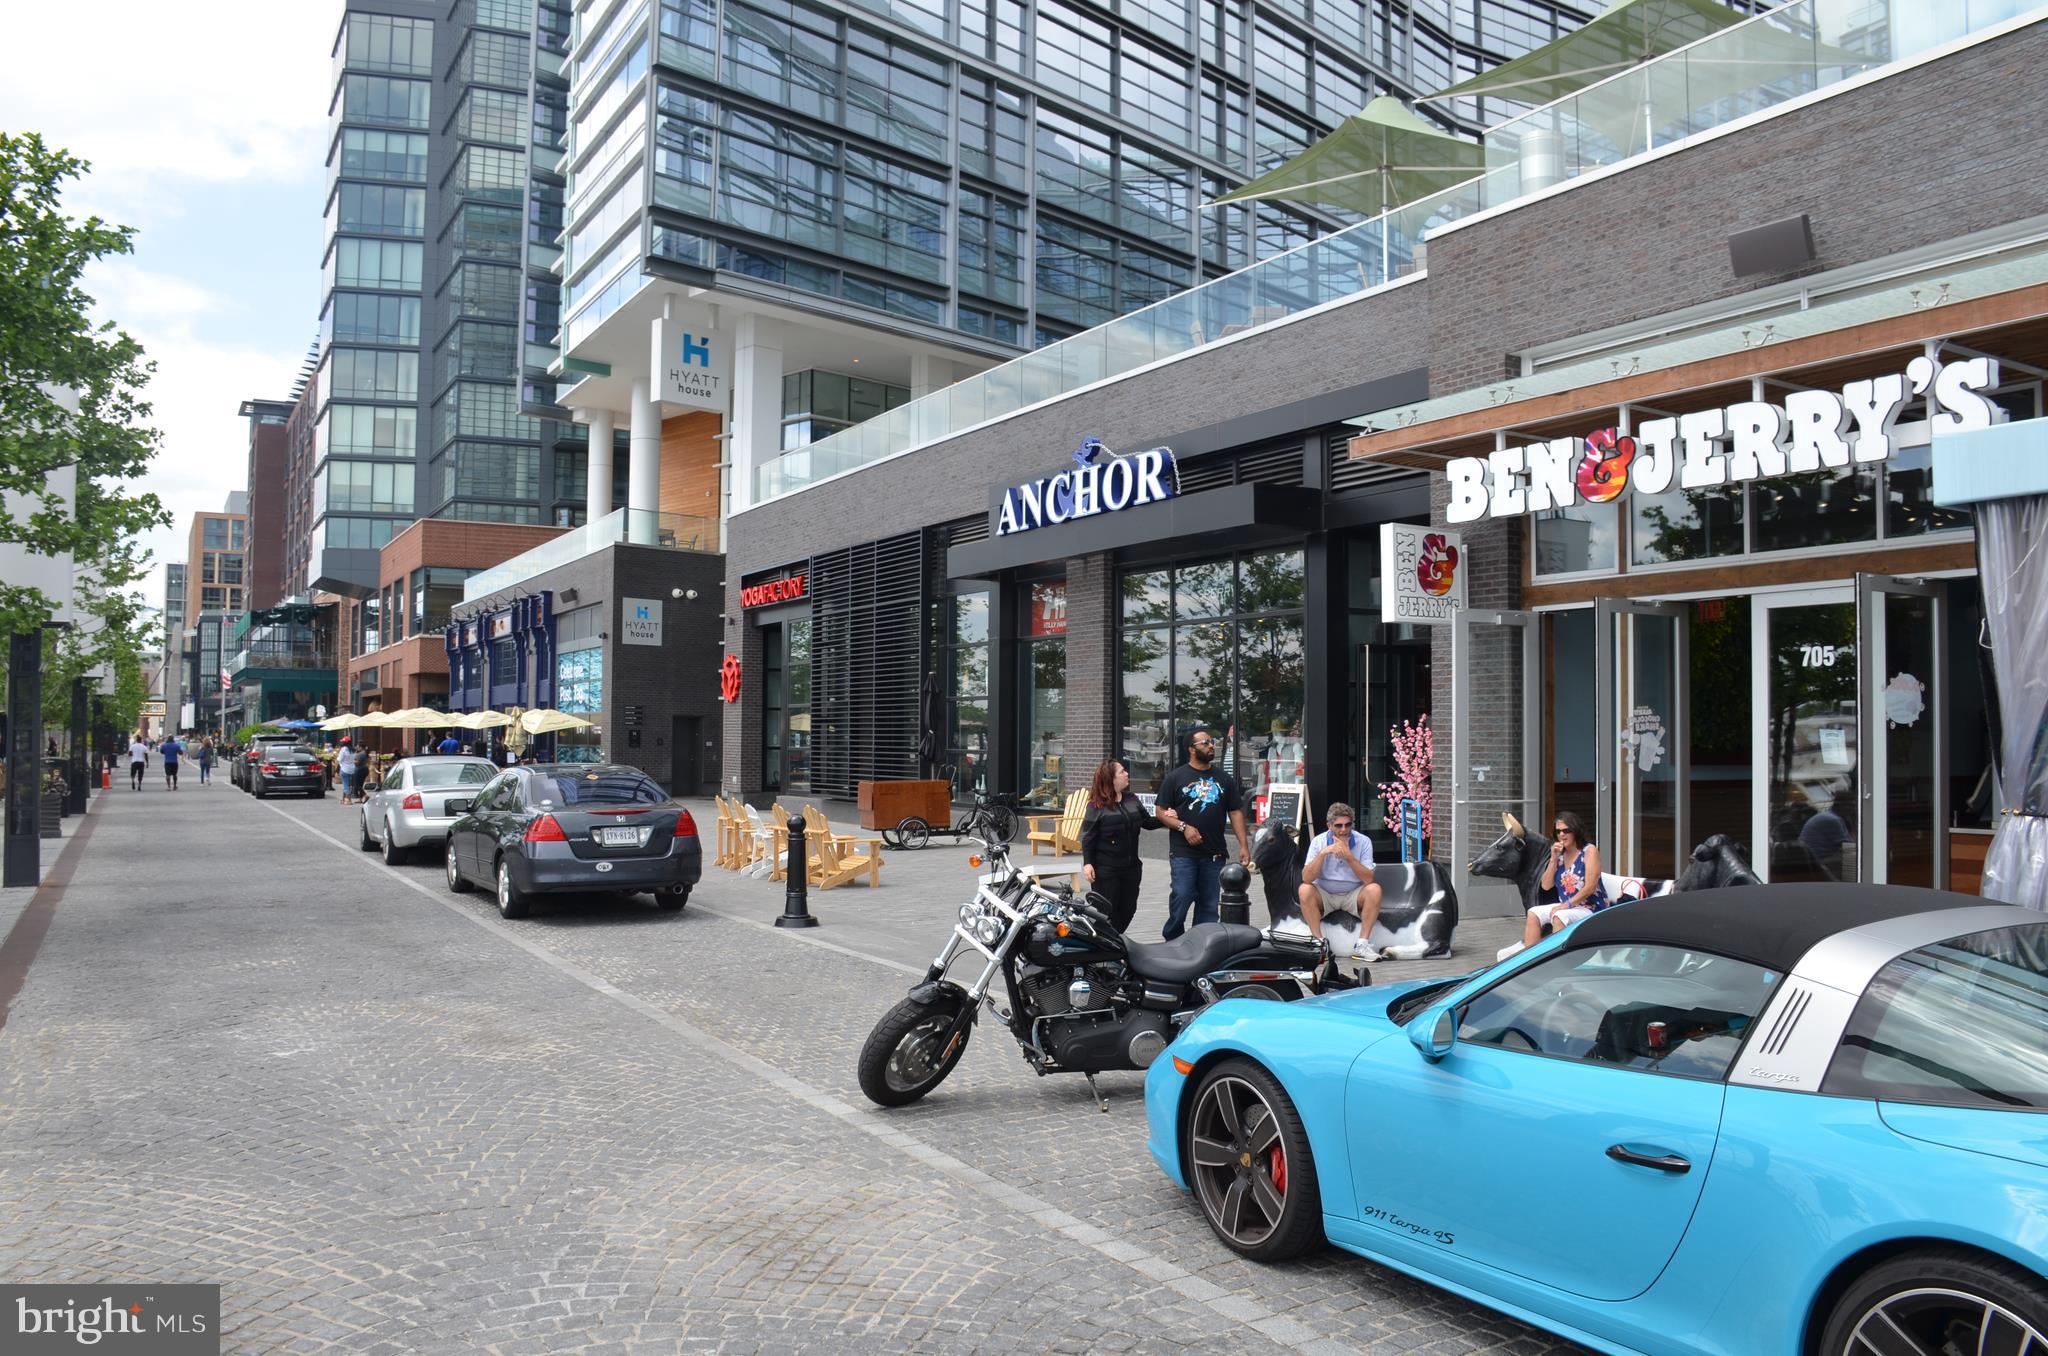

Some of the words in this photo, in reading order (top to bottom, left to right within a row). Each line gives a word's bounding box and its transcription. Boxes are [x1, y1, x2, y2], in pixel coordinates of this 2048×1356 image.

[670, 369, 720, 388] HYATT
[678, 383, 711, 398] house
[996, 449, 1169, 535] ANCHOR
[1396, 532, 1416, 592] BEN
[626, 621, 660, 631] HYATT
[630, 630, 654, 639] house
[1800, 645, 1835, 667] 705
[1364, 1206, 1387, 1220] 911
